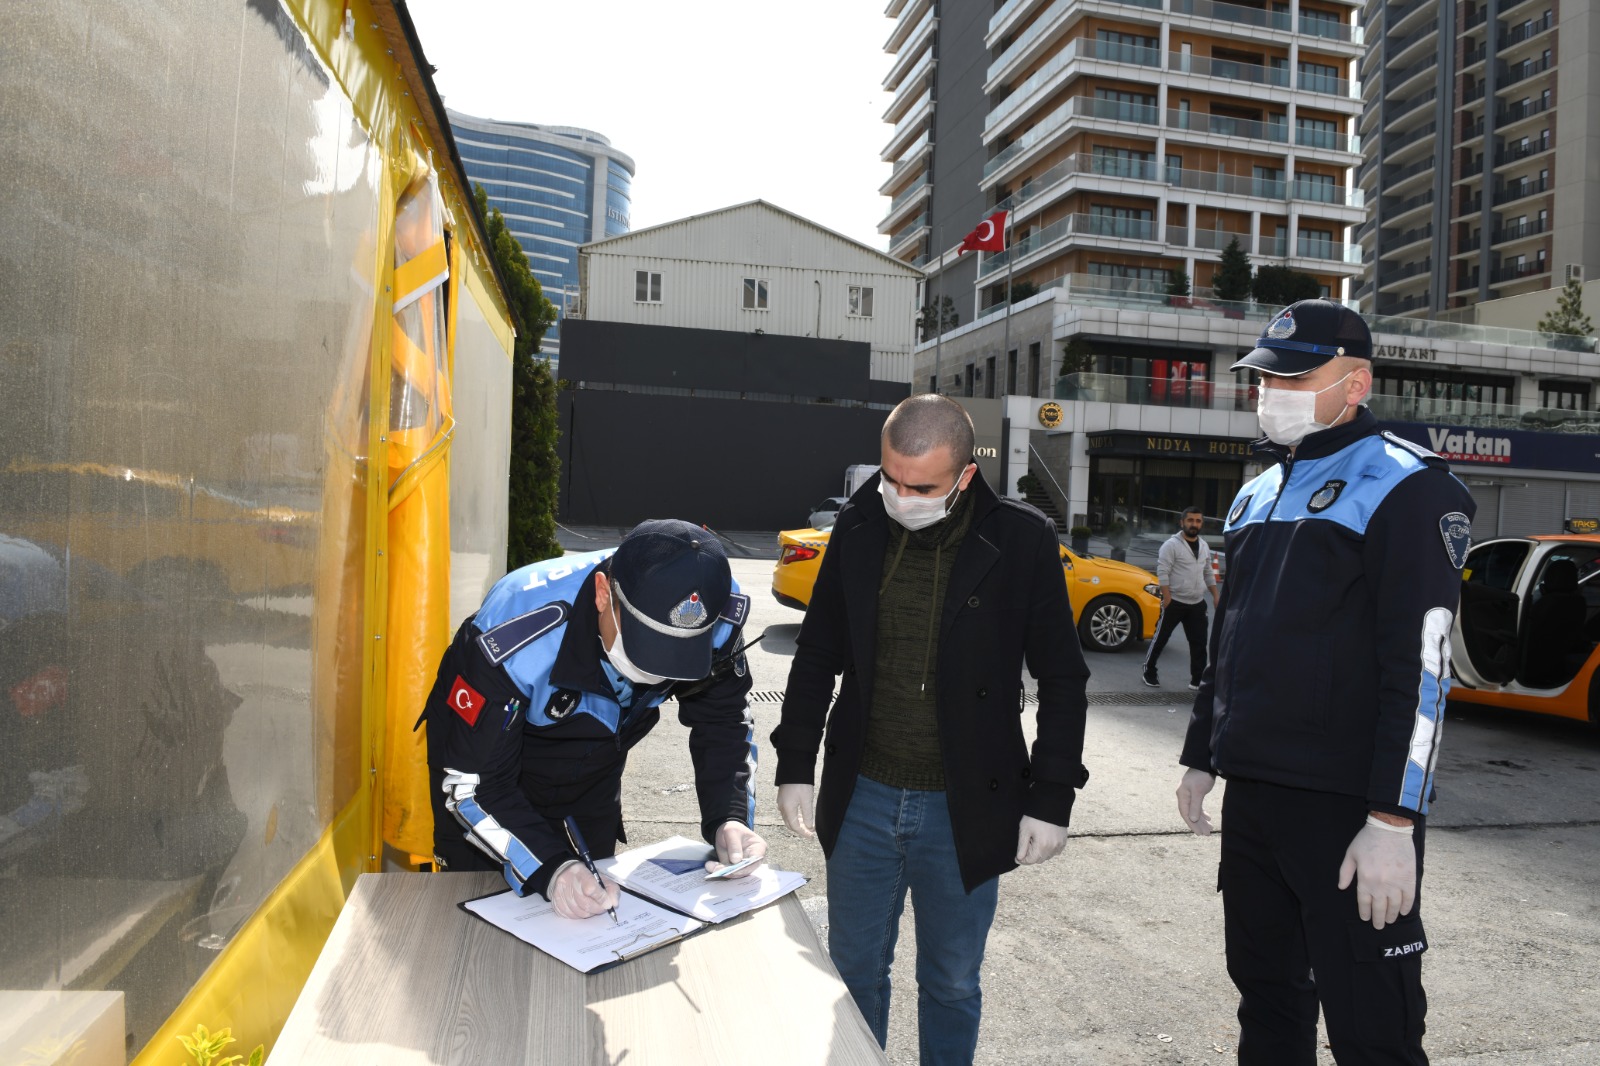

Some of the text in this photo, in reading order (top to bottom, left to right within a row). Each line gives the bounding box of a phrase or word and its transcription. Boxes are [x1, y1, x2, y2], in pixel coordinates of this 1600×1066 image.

[1147, 438, 1253, 455] NIDYA HOTEL
[1427, 427, 1511, 457] Vatan
[1439, 453, 1504, 463] OMPUTER
[487, 637, 500, 654] 242
[1384, 941, 1424, 957] ZABITA
